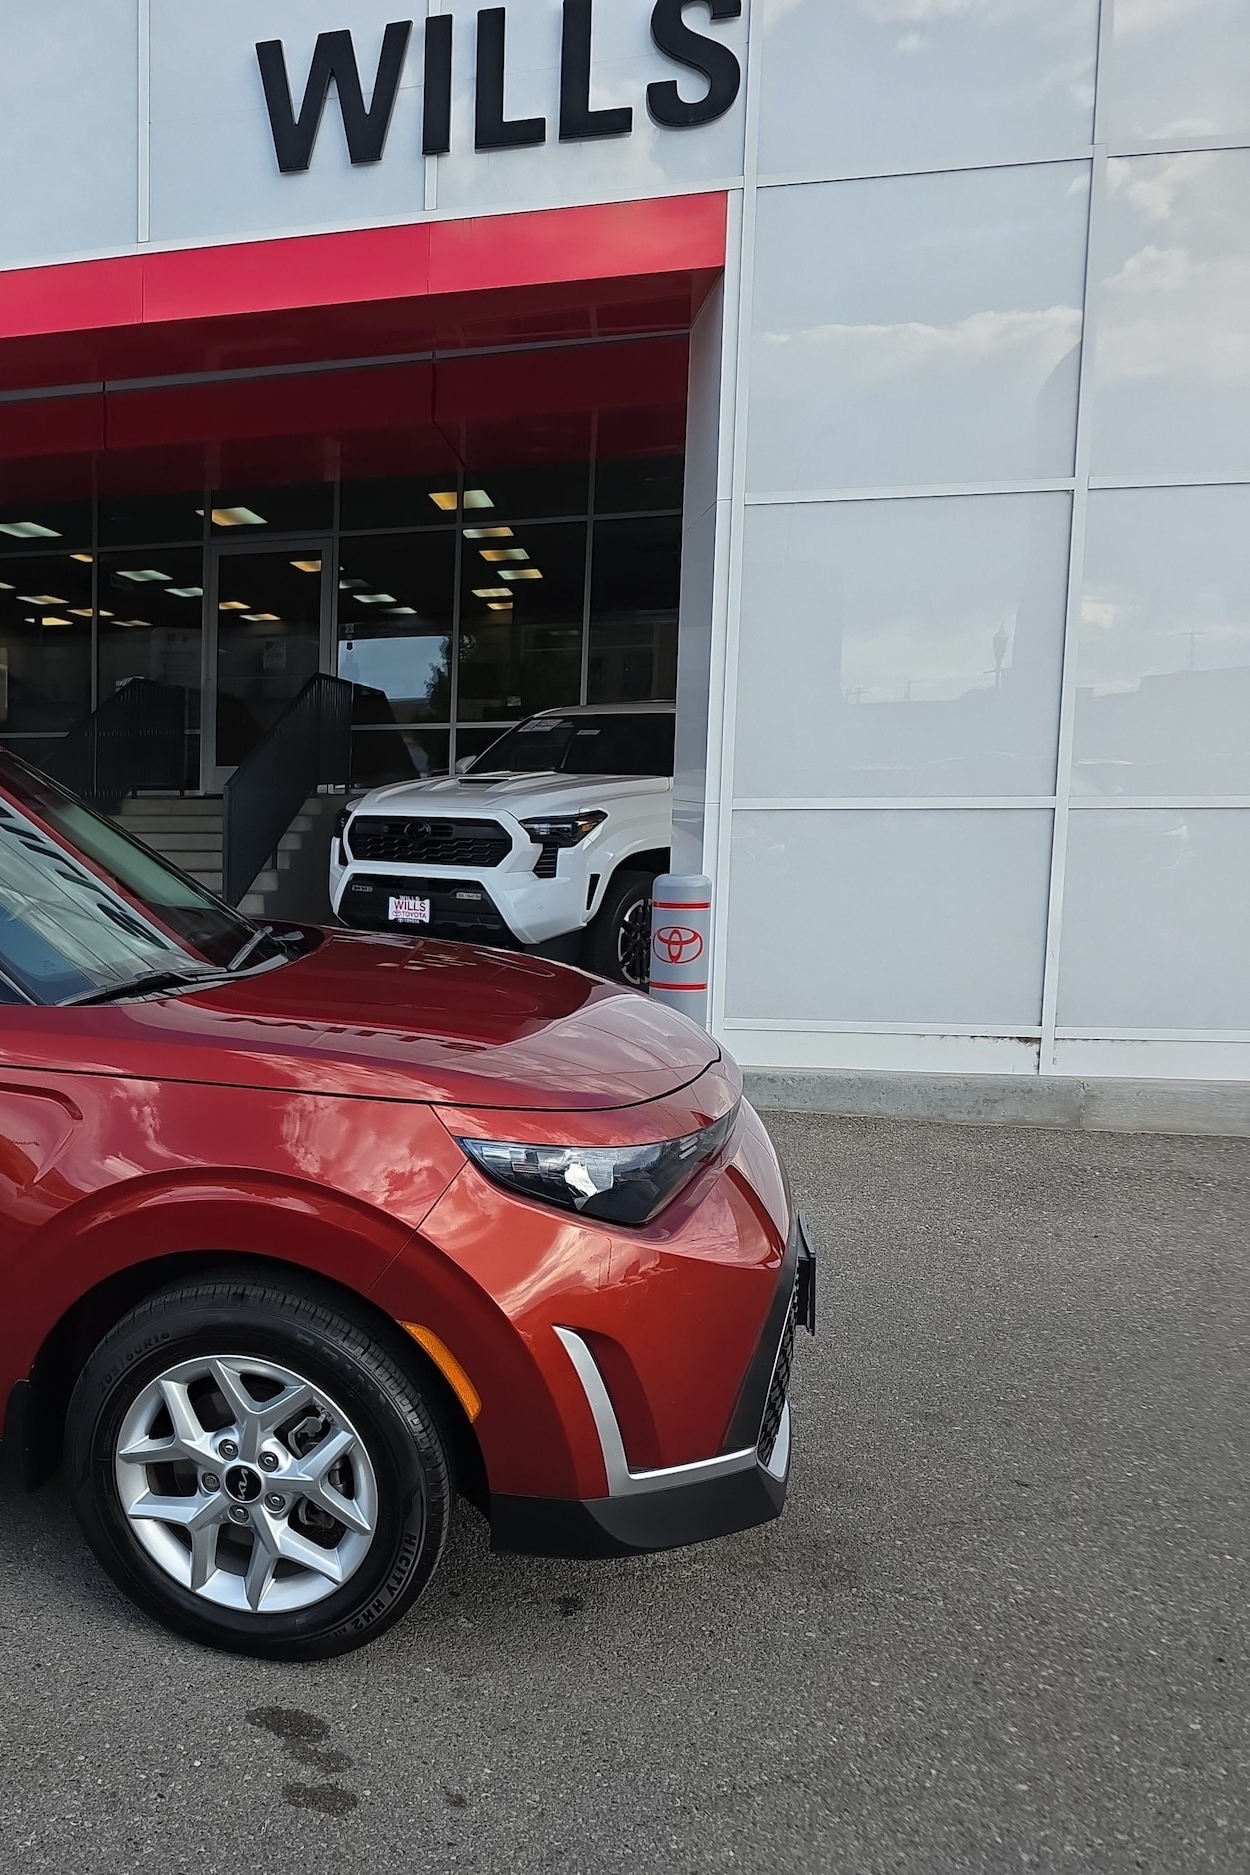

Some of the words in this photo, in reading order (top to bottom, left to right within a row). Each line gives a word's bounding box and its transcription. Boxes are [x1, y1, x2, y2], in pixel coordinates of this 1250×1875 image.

[255, 0, 741, 174] WILLS
[394, 900, 426, 912] WILLS
[402, 911, 427, 919] TOYOTA
[351, 1598, 386, 1631] HH2
